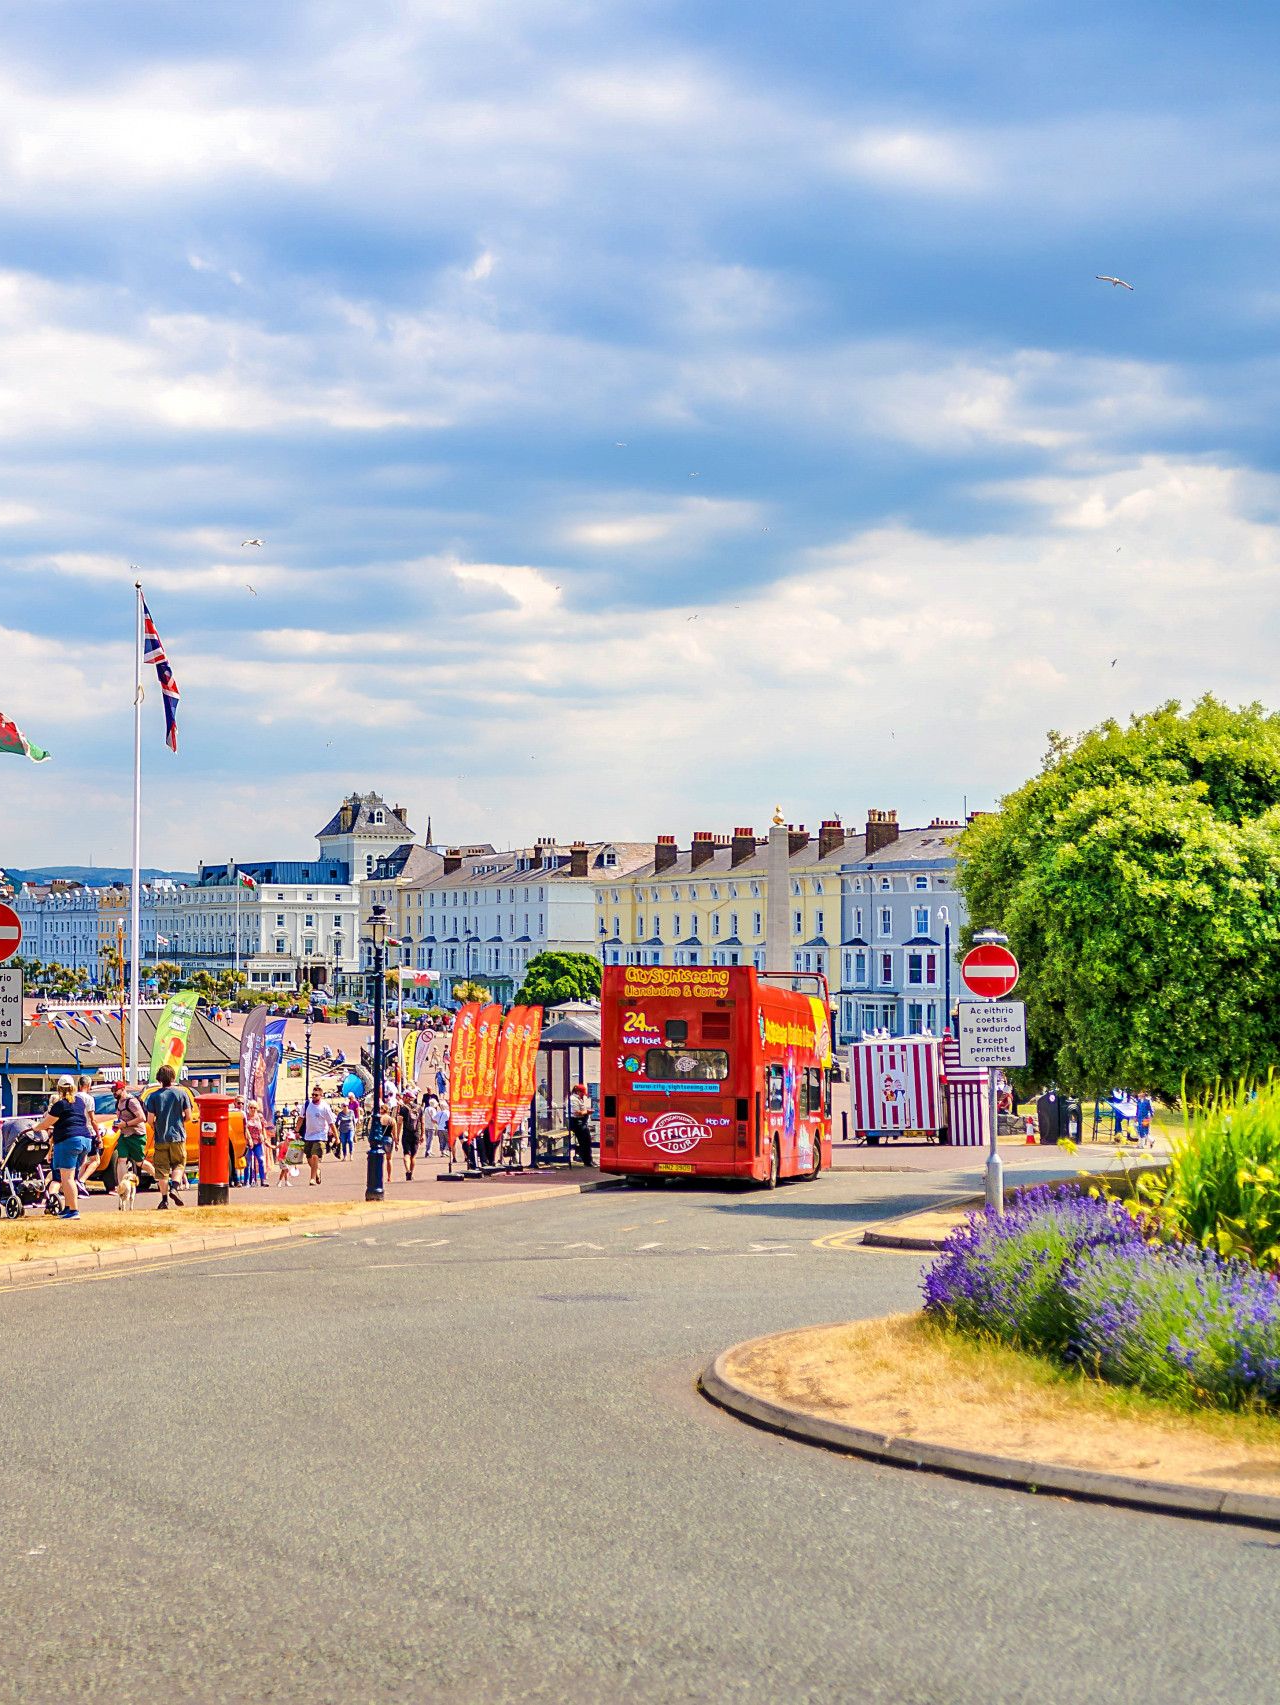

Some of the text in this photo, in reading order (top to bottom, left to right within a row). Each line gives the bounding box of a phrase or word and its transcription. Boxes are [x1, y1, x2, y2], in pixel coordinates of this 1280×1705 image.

[625, 967, 730, 985] CitySightseeing
[625, 985, 729, 998] Llandudno & Conwy
[623, 1036, 640, 1044] Valid
[641, 1036, 662, 1045] Ticket
[970, 1045, 1015, 1054] permitted
[462, 1023, 476, 1098] Explorer
[625, 1116, 638, 1124] Hop
[705, 1118, 730, 1126] Hop Off
[649, 1127, 708, 1143] OFFICIAL
[667, 1139, 693, 1150] TOUR
